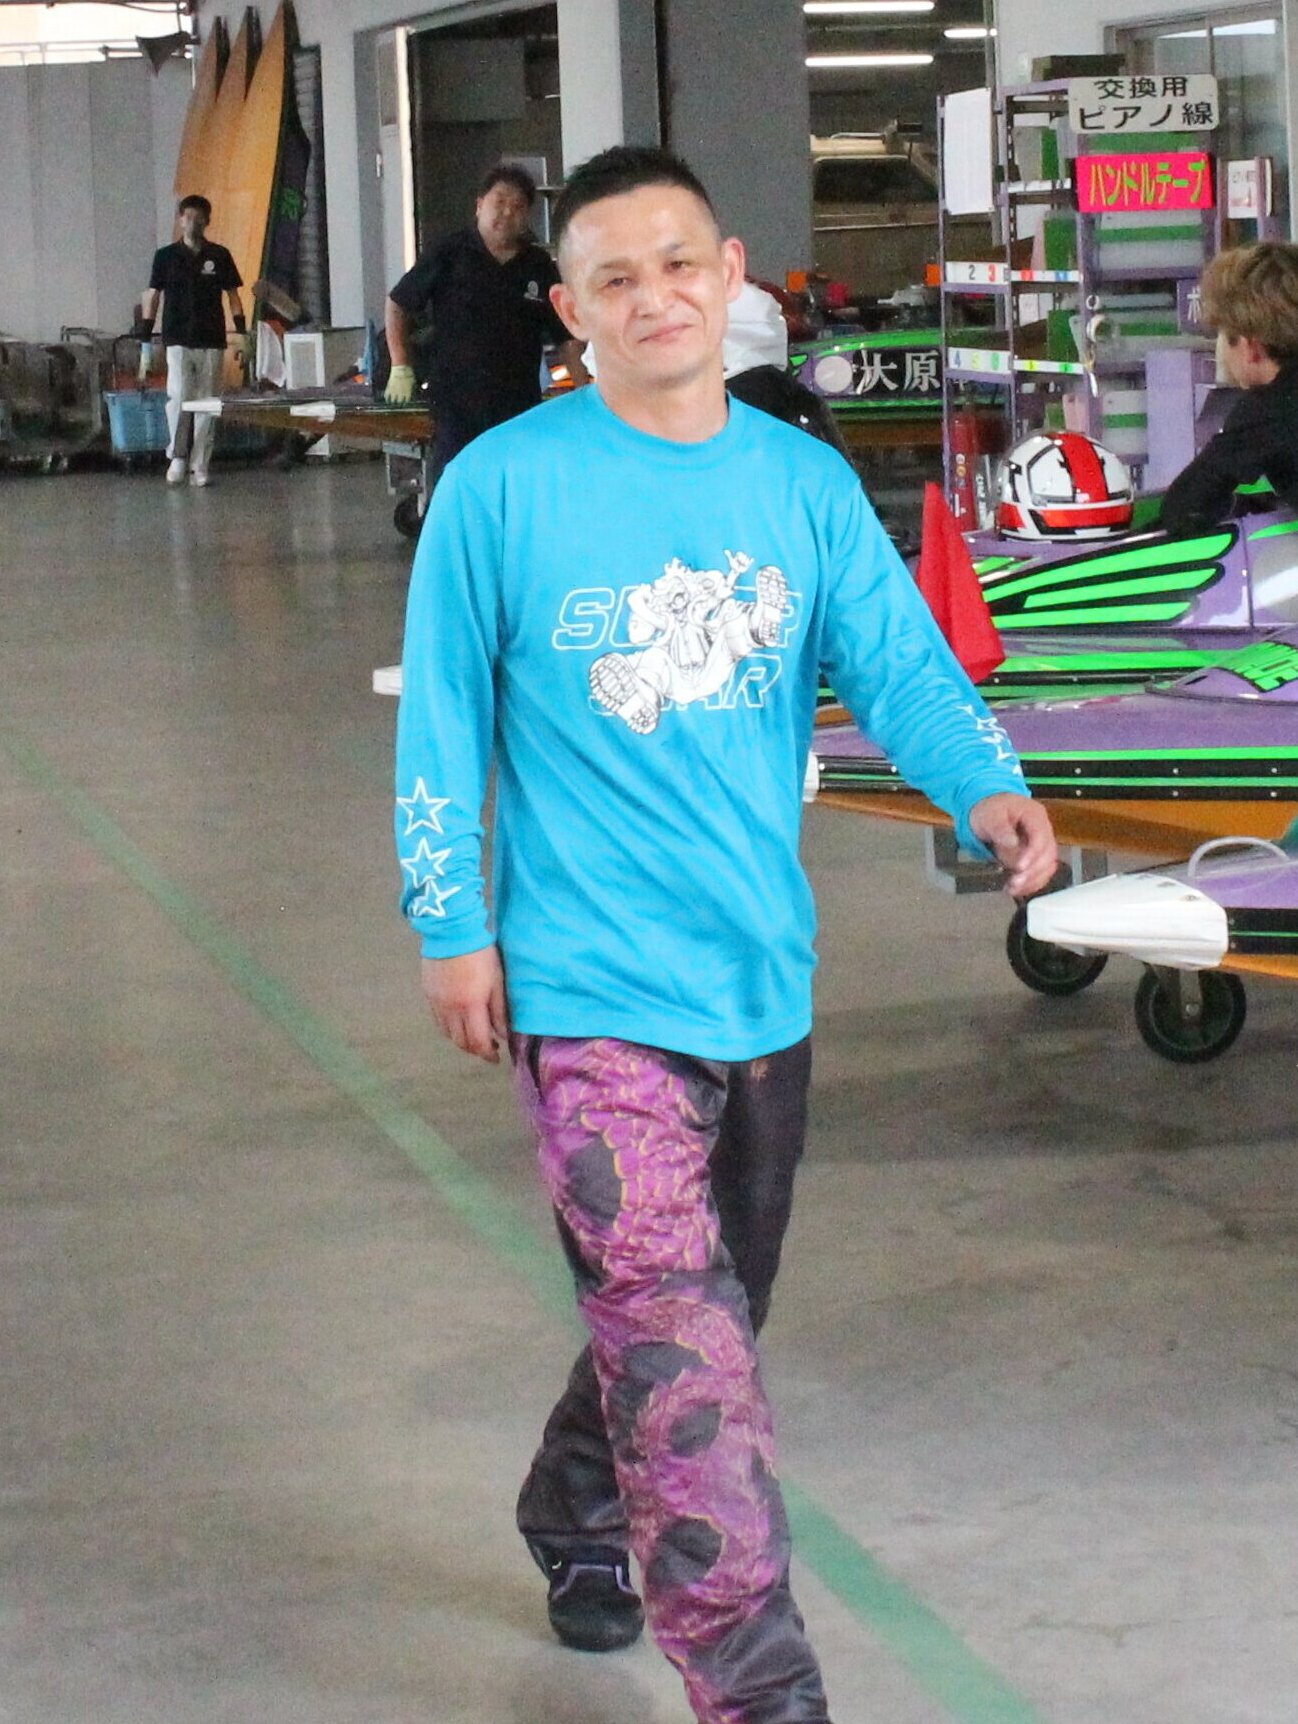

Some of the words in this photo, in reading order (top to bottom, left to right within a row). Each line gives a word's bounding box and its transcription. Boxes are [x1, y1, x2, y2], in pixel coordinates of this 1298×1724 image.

[1094, 76, 1188, 99] 交換用
[1079, 102, 1213, 129] ピアノ線
[1090, 159, 1206, 206] ハンドルテープ
[968, 264, 976, 280] 2
[988, 264, 997, 282] 3
